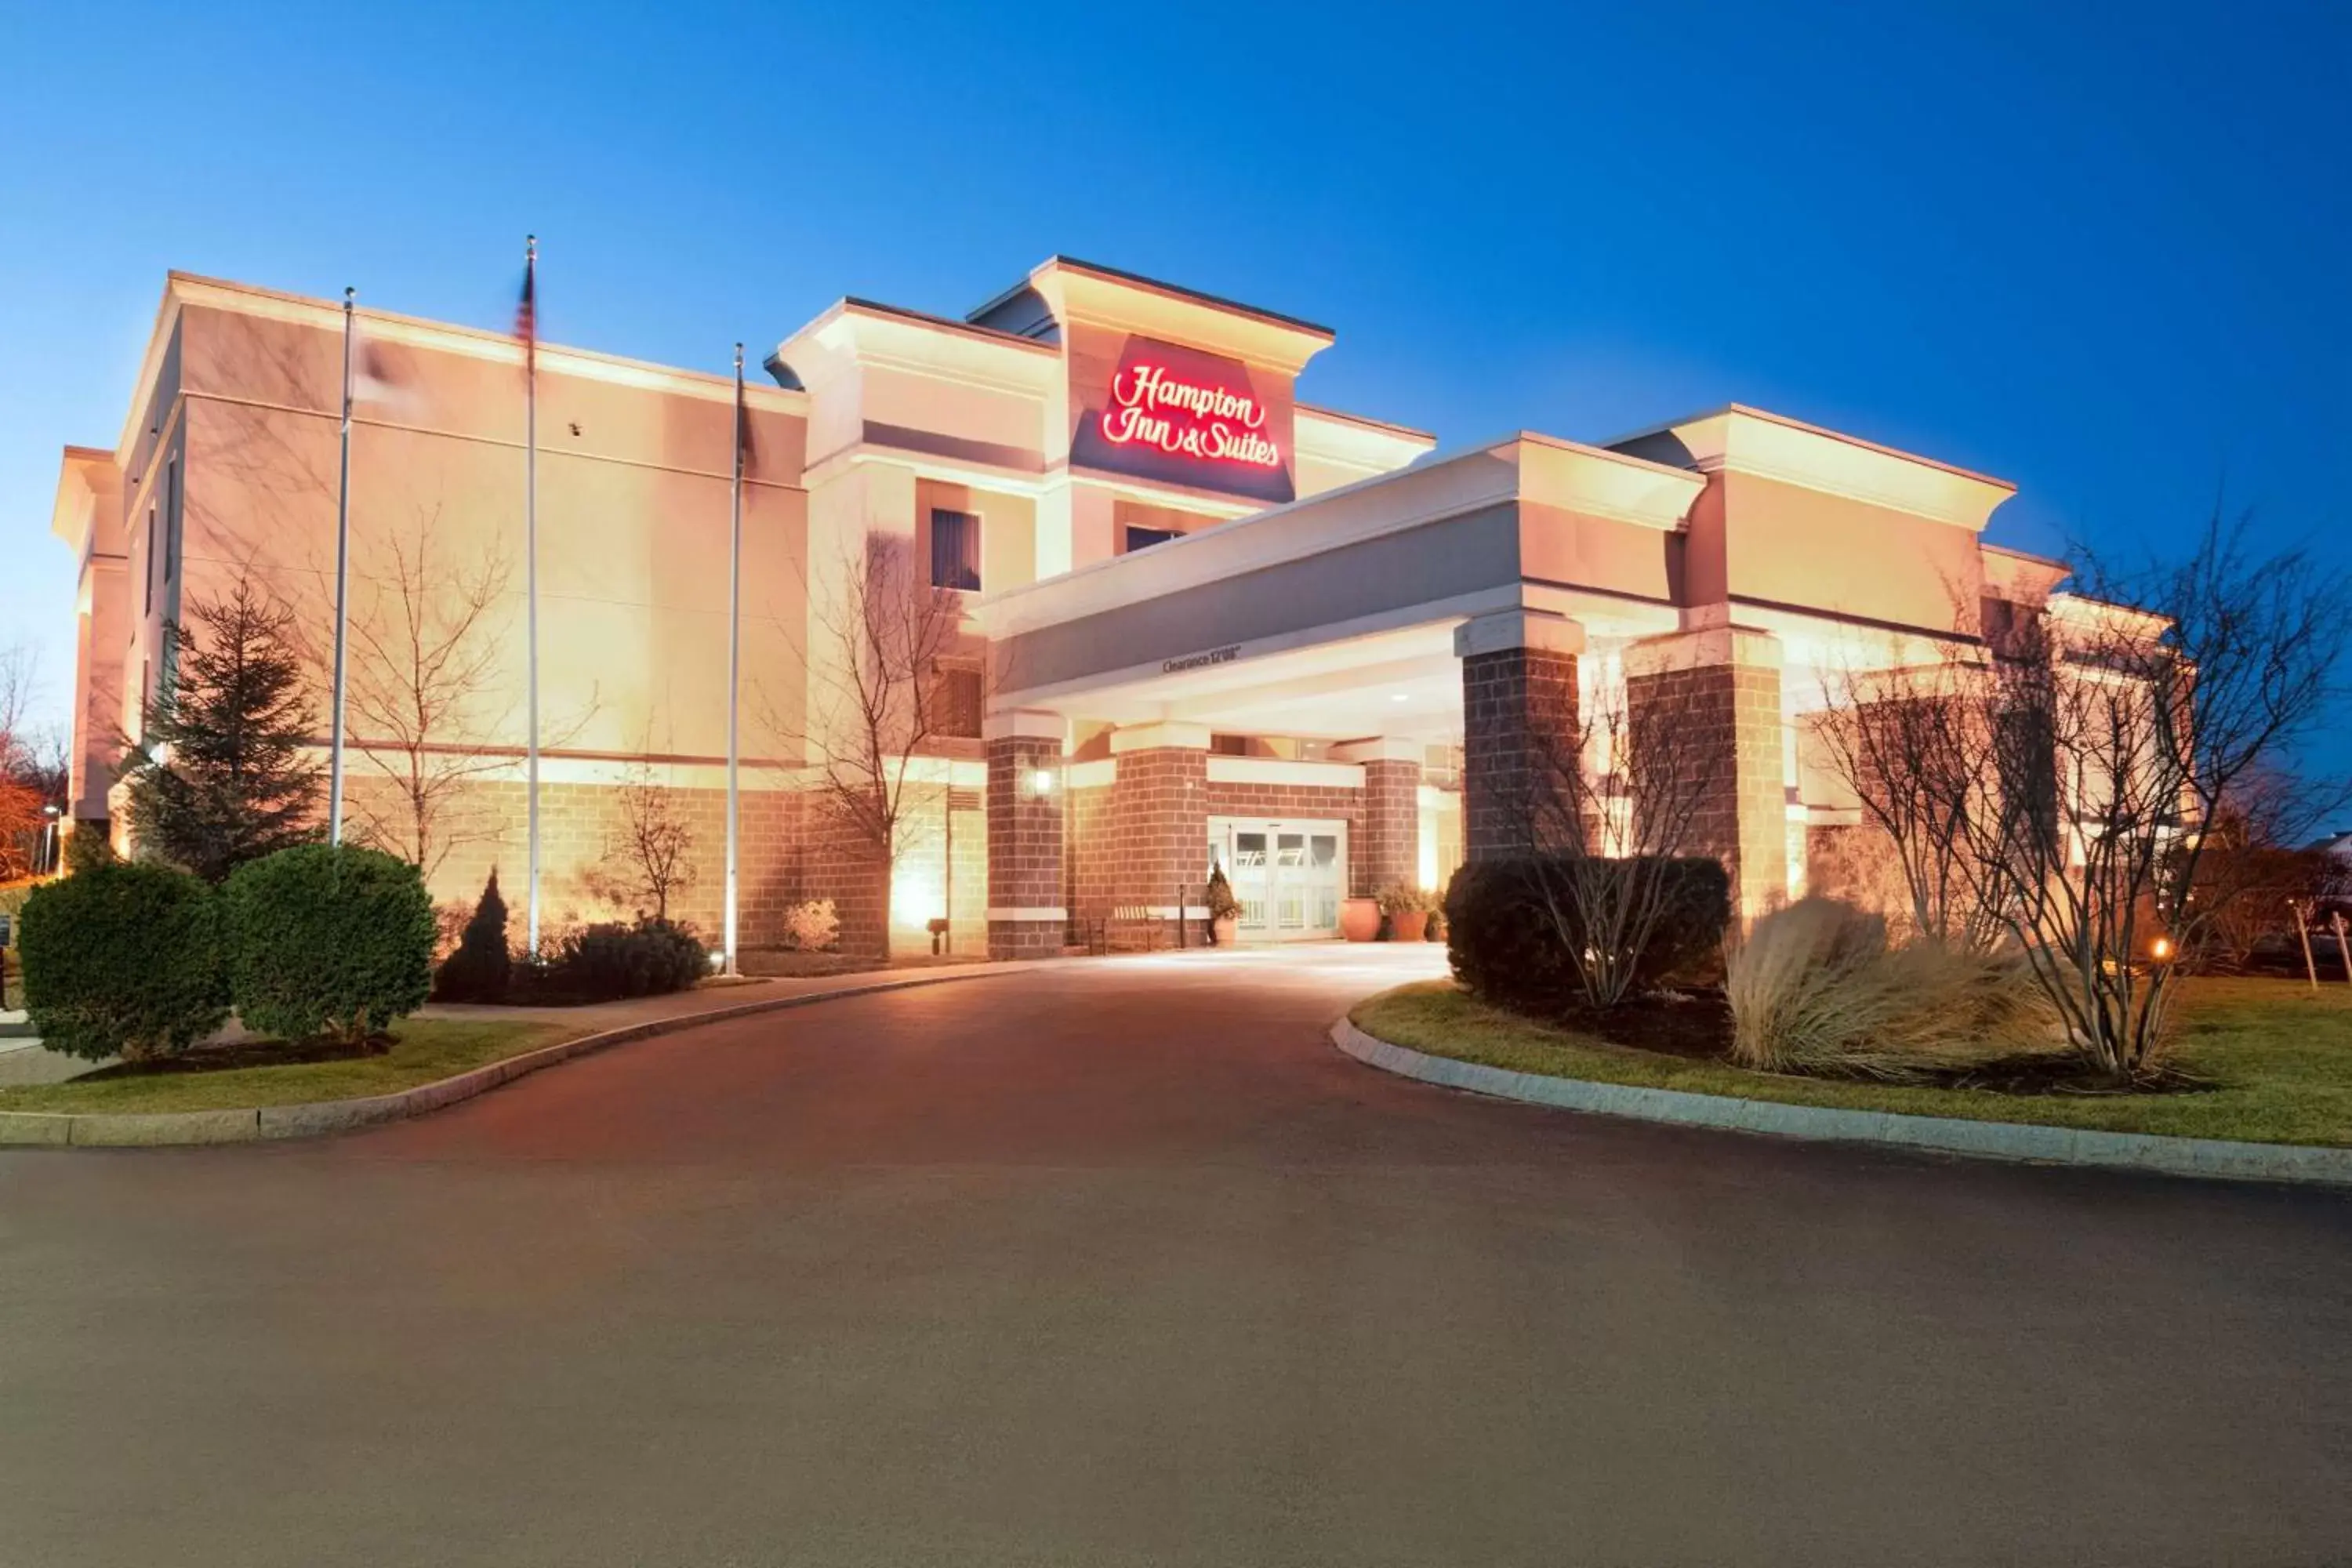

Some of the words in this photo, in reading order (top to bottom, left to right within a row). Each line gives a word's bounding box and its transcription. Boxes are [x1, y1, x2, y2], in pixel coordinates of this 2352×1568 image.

[1114, 366, 1265, 427] Hampton
[1103, 407, 1182, 452] Inn
[1183, 427, 1203, 457] &
[1200, 423, 1279, 466] Suites
[1163, 655, 1209, 673] Clearance
